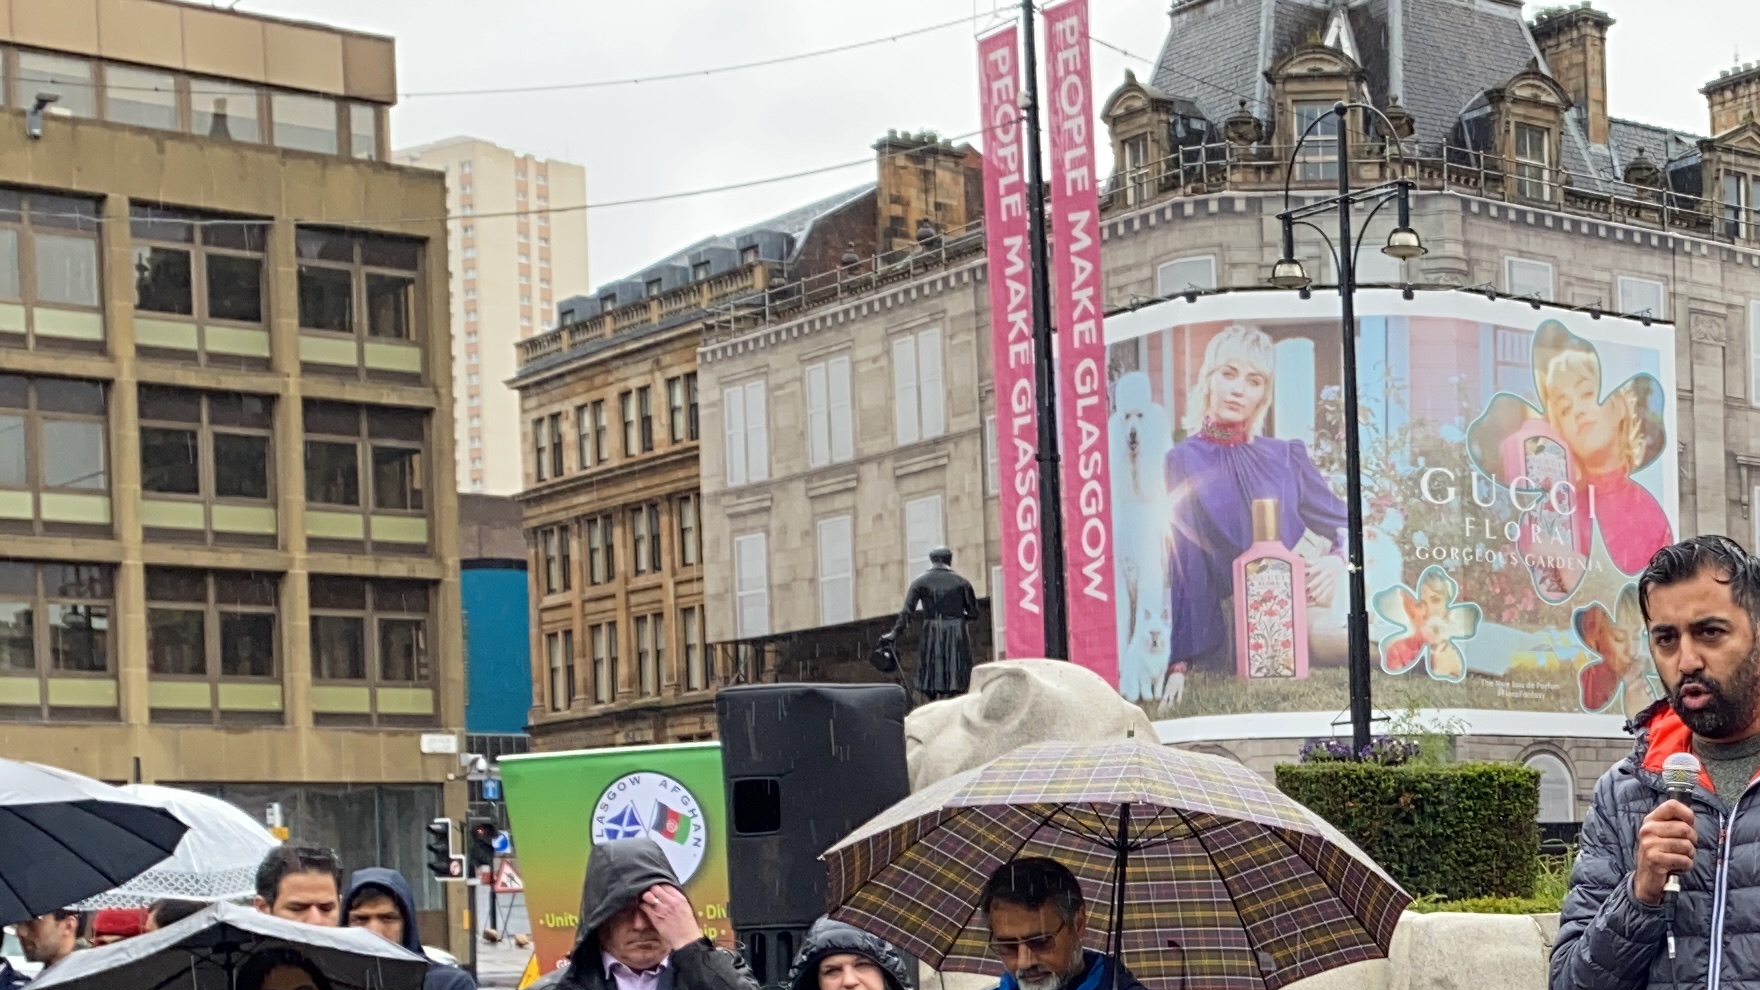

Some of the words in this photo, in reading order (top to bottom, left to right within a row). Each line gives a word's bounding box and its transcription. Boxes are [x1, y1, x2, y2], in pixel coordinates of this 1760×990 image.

[988, 46, 1022, 221] PEOPLE
[1056, 15, 1089, 196] PEOPLE
[1003, 235, 1030, 368] MAKE
[1068, 210, 1096, 348] MAKE
[1011, 378, 1039, 615] GLASGOW
[1074, 358, 1107, 601] GLASGOW
[1420, 467, 1595, 518] GUCCI
[1465, 517, 1564, 545] FLORA
[1416, 546, 1518, 567] GORGEOUS
[1525, 553, 1602, 572] GARDENIA
[596, 776, 640, 838] LASGOW
[659, 780, 702, 848] AFGHAN
